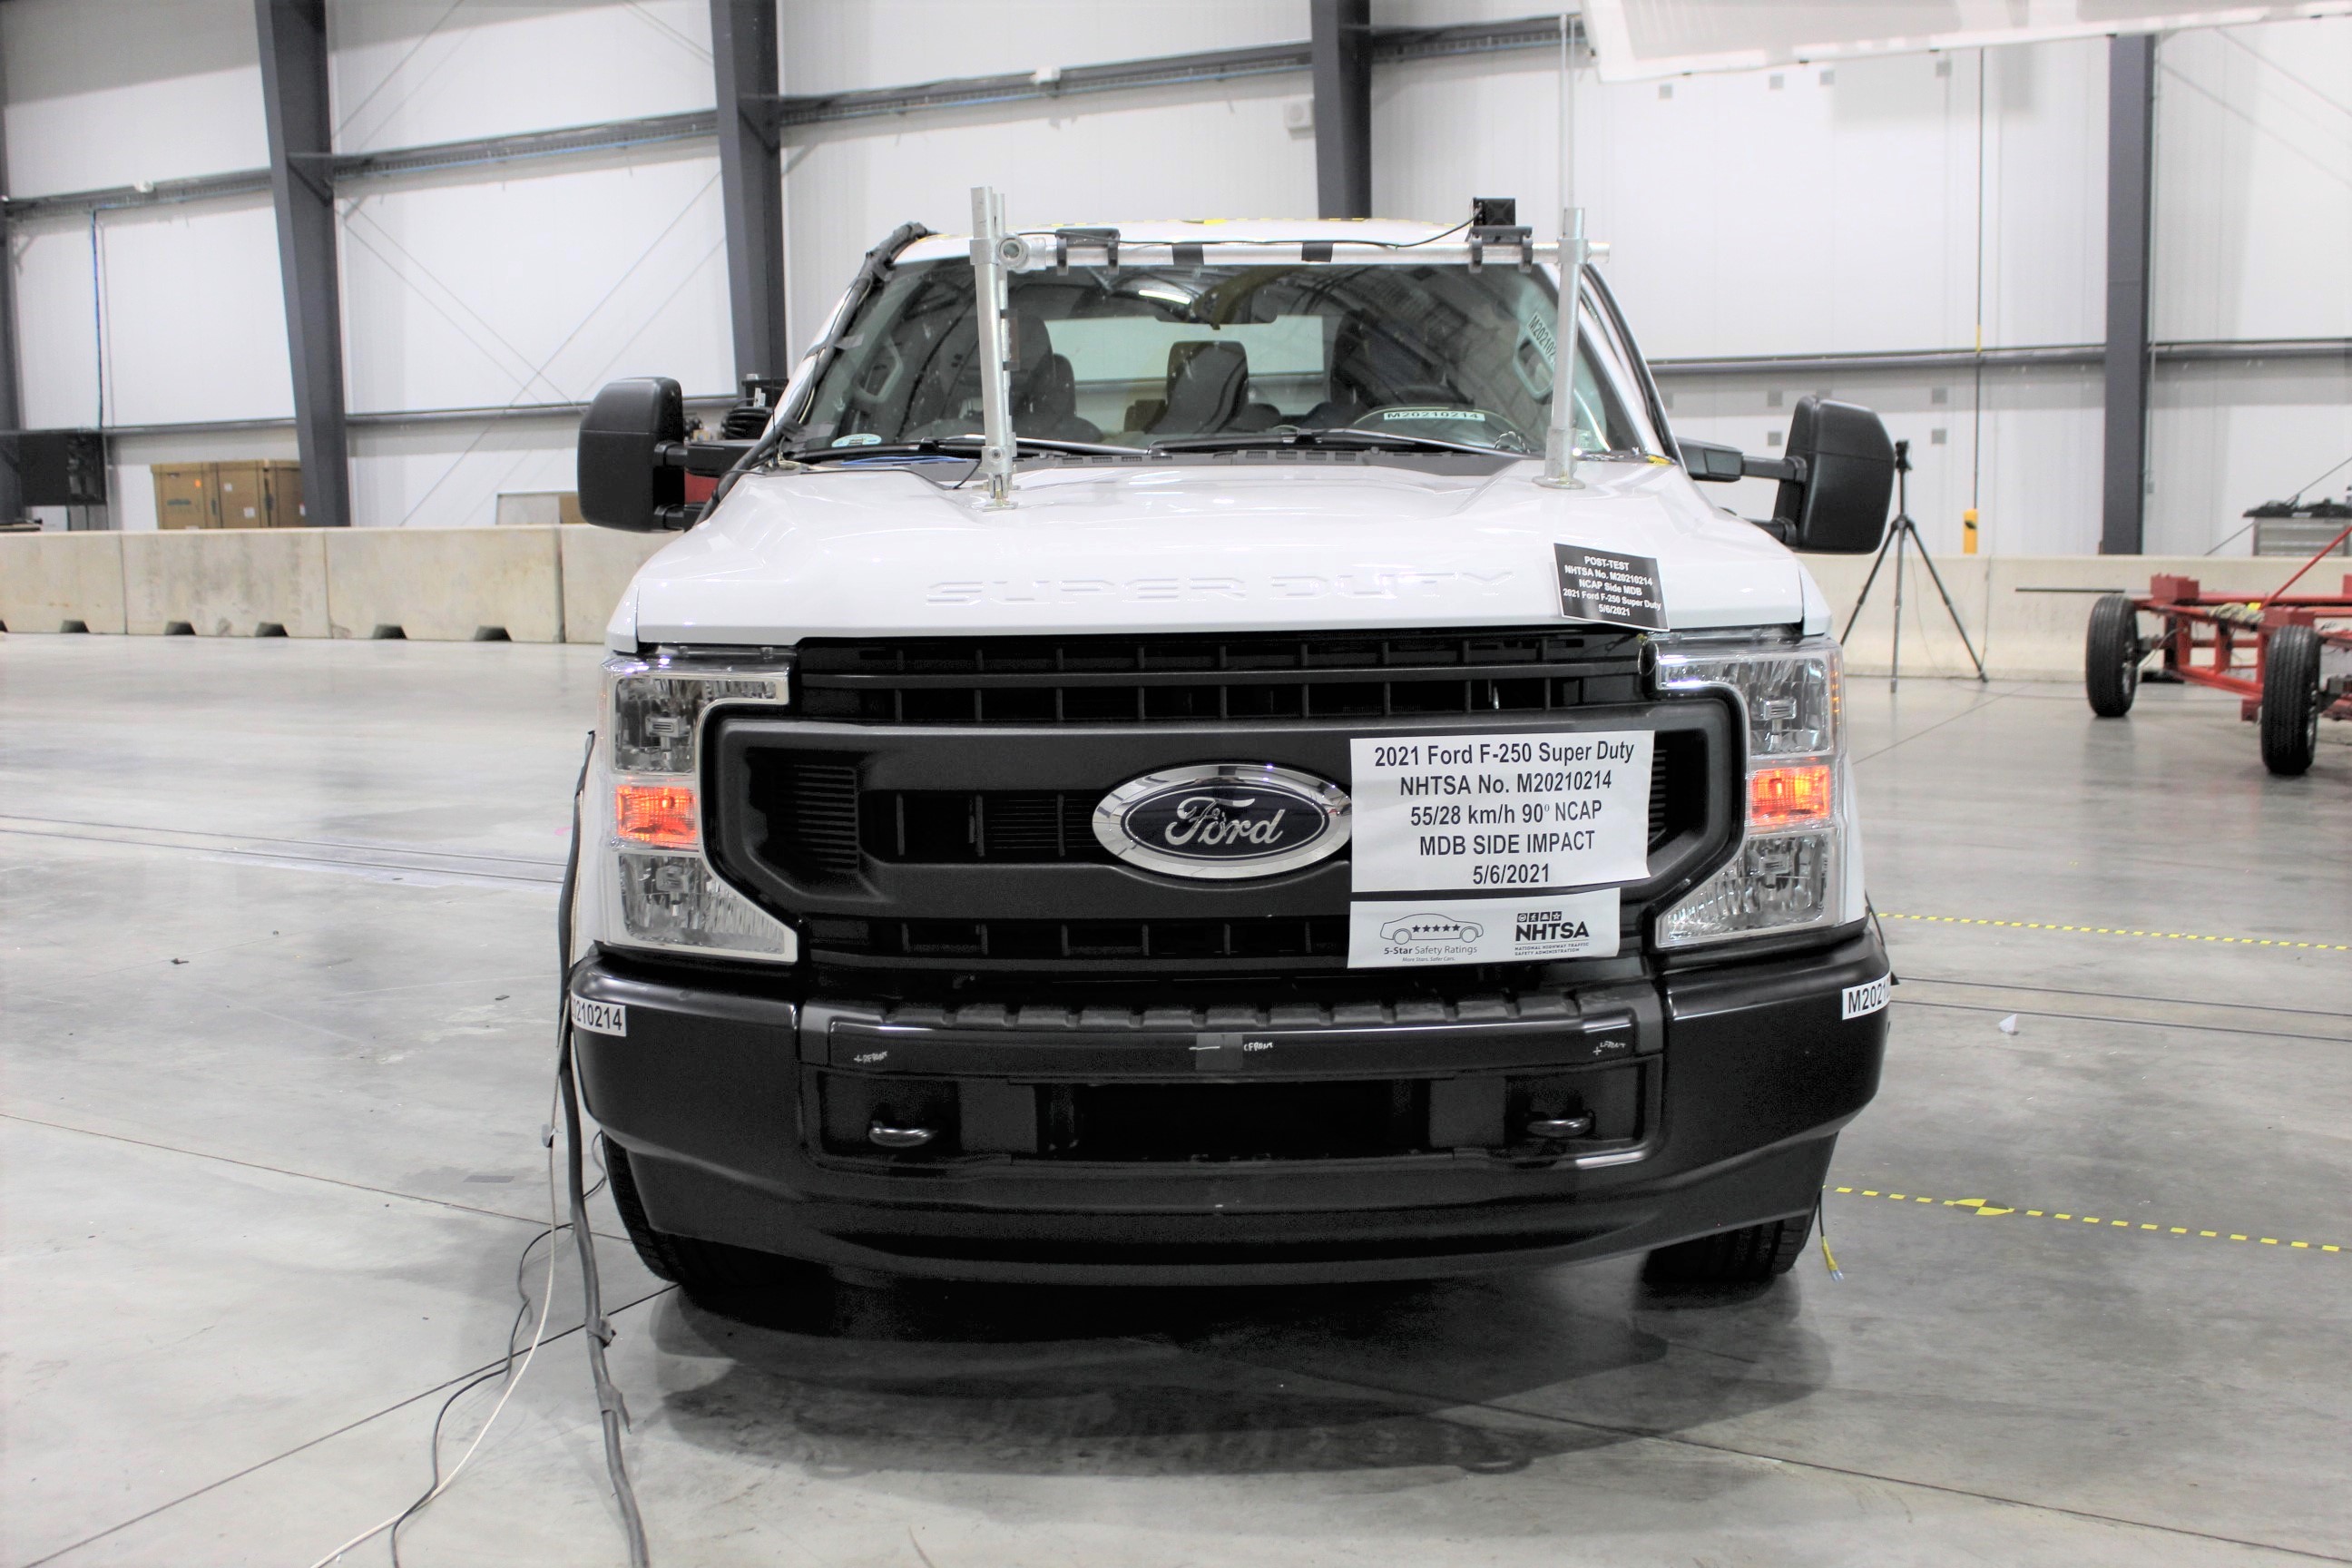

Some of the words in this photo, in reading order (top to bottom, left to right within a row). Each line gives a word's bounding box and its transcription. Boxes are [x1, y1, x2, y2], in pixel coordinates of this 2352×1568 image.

[1387, 411, 1480, 419] M20210214
[1583, 555, 1630, 571] POST-TEST
[1563, 564, 1594, 577] NHTSA
[1594, 568, 1609, 580] No.
[1609, 571, 1653, 586] M20210214
[926, 576, 1247, 605] SUPER
[1269, 570, 1516, 600] DUTY
[1578, 578, 1603, 590] NCAP
[1603, 582, 1622, 593] Side
[1622, 584, 1643, 596] MDB
[1563, 588, 1581, 598] 2021
[1581, 590, 1600, 601] Ford
[1600, 593, 1622, 604] F-250
[1621, 595, 1643, 608] Super
[1643, 599, 1662, 612] Duty
[1598, 603, 1631, 617] 5/6/2021
[1375, 746, 1418, 767] 2021
[1427, 744, 1473, 765] Ford
[1480, 742, 1532, 764] F-250
[1538, 741, 1592, 767] Super
[1597, 740, 1635, 764] Duty
[1400, 774, 1472, 796] NHTSA
[1478, 774, 1510, 794] No.
[1516, 769, 1612, 793] M20210214
[1165, 796, 1285, 845] Ford
[1410, 805, 1462, 827] 55/28
[1468, 803, 1515, 825] km/h
[1555, 799, 1602, 822] NCAP
[1420, 835, 1466, 856] MDB
[1473, 834, 1520, 855] SIDE
[1527, 830, 1595, 854] IMPACT
[1473, 863, 1550, 885] 5/6/2021
[1514, 921, 1590, 942] NHTSA
[1384, 946, 1413, 955] 5-Star
[1414, 946, 1442, 956] Safety
[1444, 946, 1477, 956] Ratings
